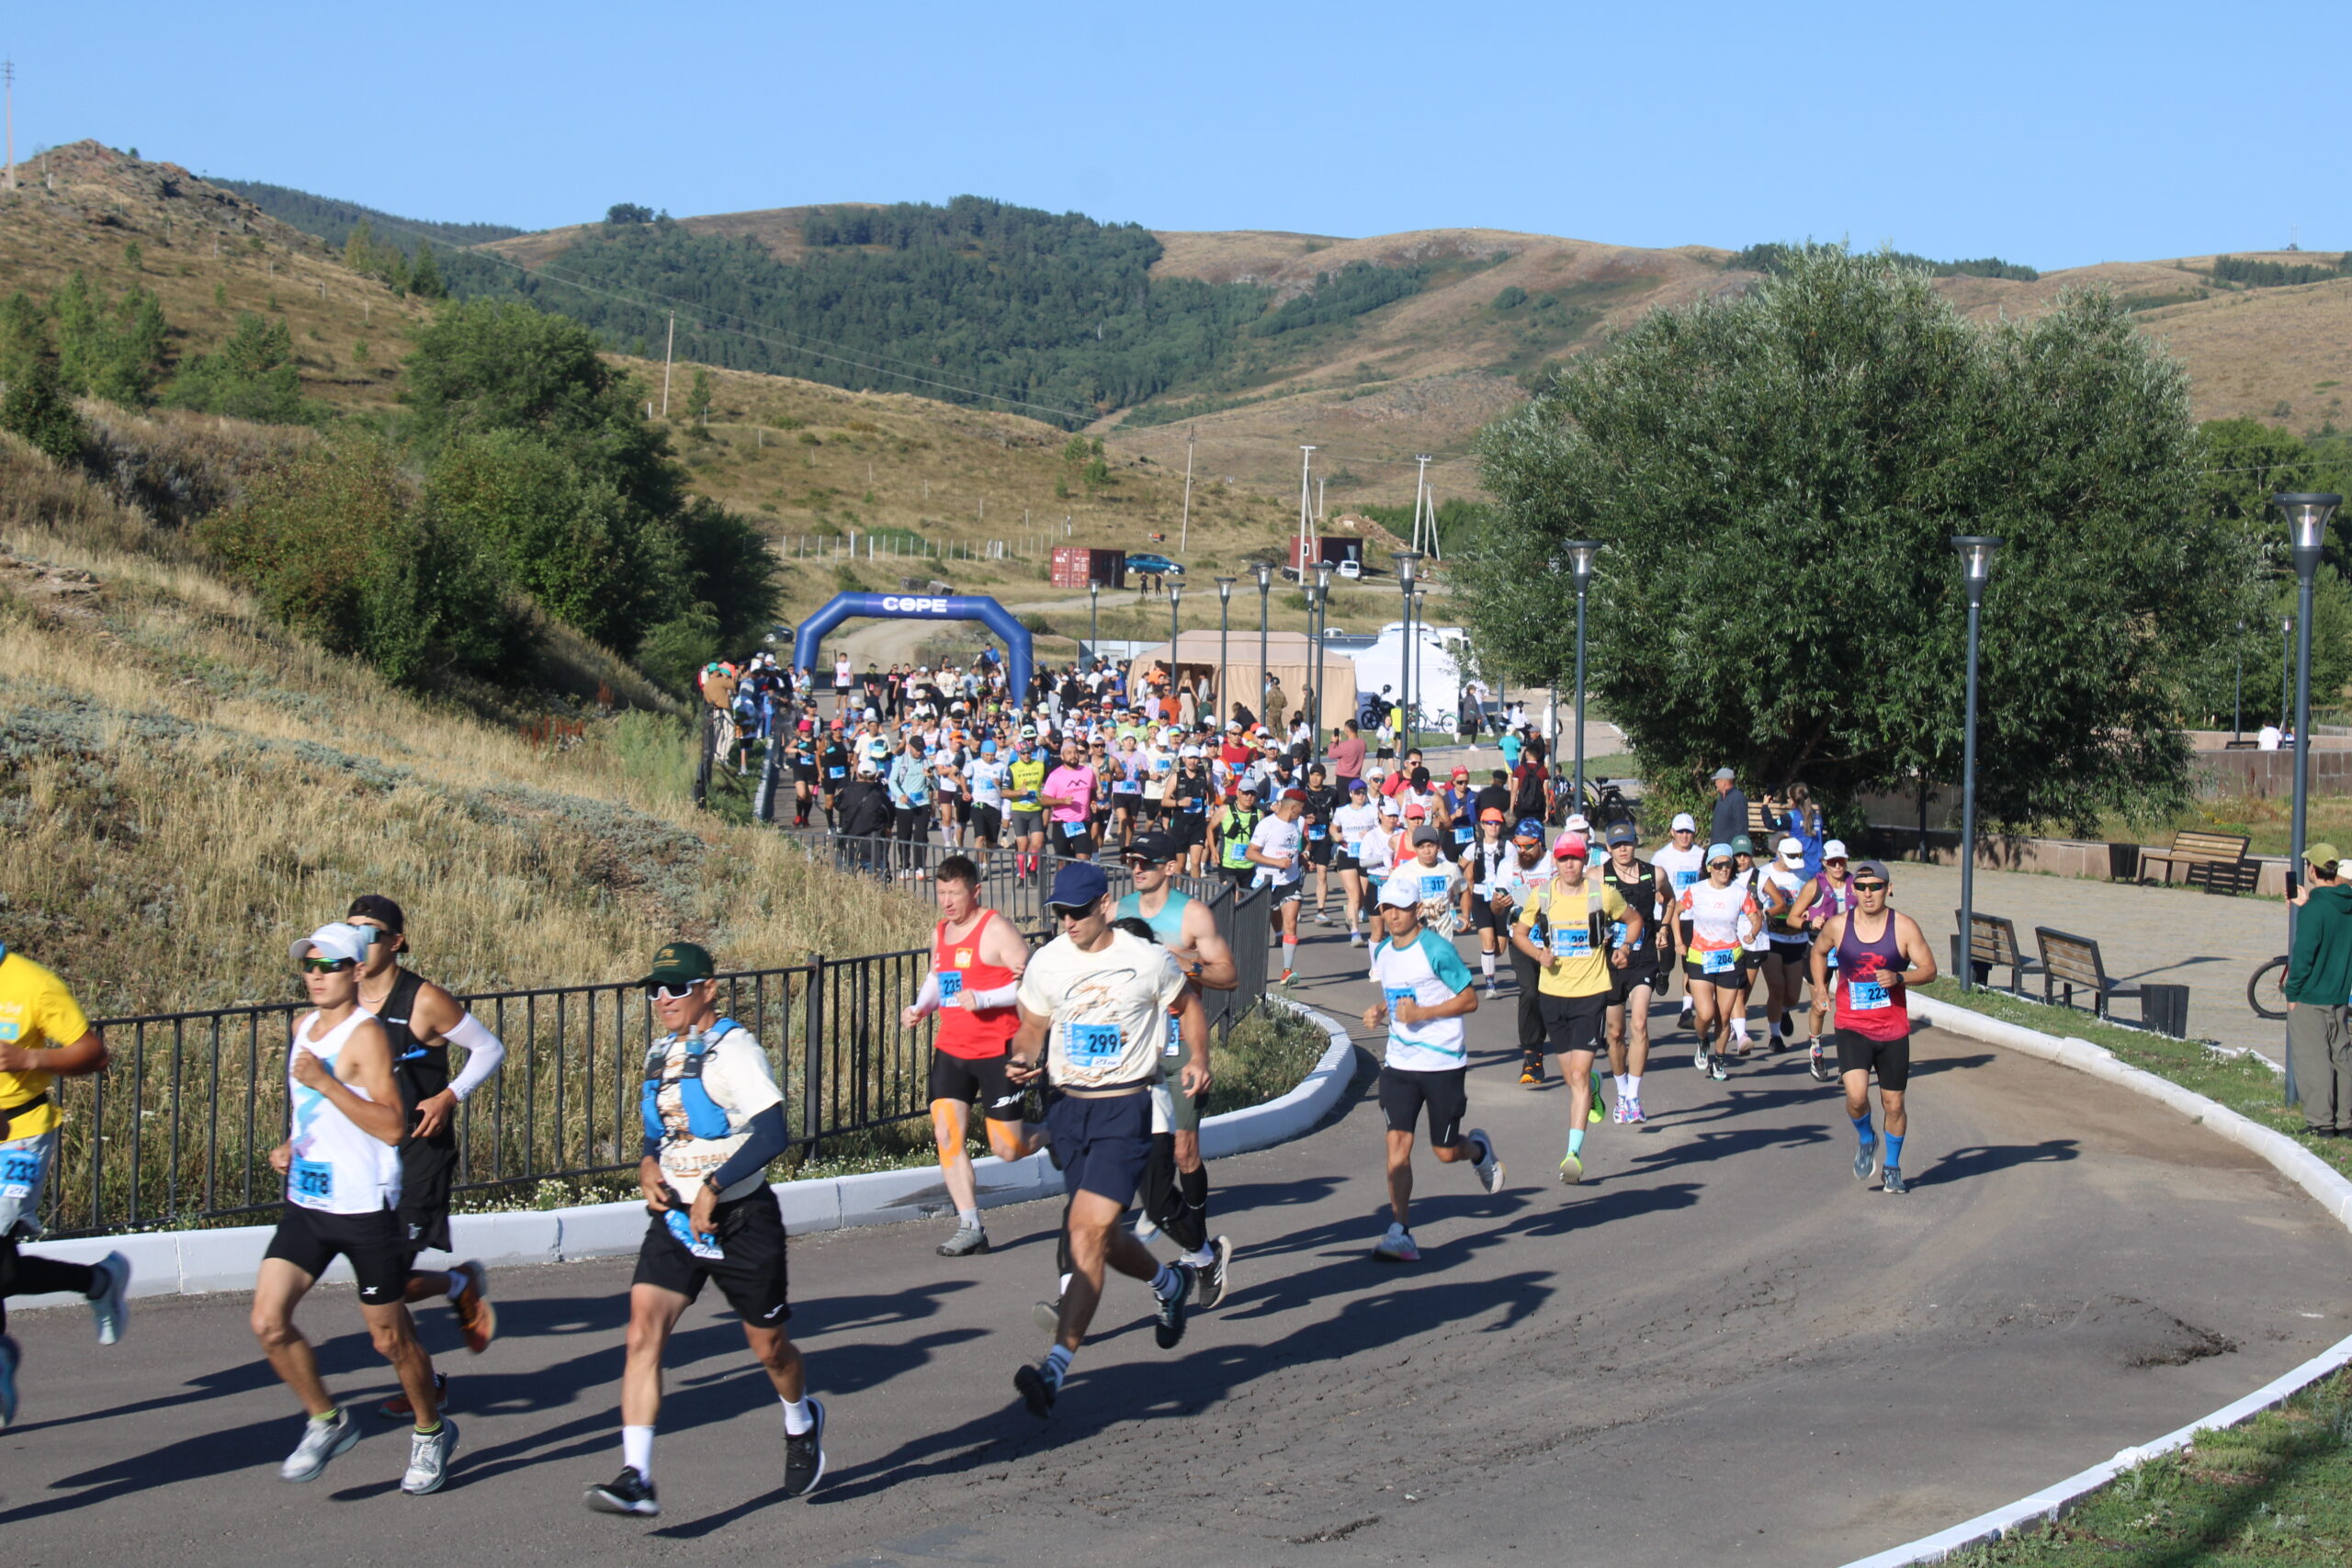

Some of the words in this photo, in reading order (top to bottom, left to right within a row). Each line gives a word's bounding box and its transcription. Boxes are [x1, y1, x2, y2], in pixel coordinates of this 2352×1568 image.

[1431, 879, 1445, 890] 317
[1717, 953, 1733, 965] 206
[943, 978, 962, 996] 235
[1868, 987, 1888, 1001] 223
[1089, 1033, 1118, 1054] 299
